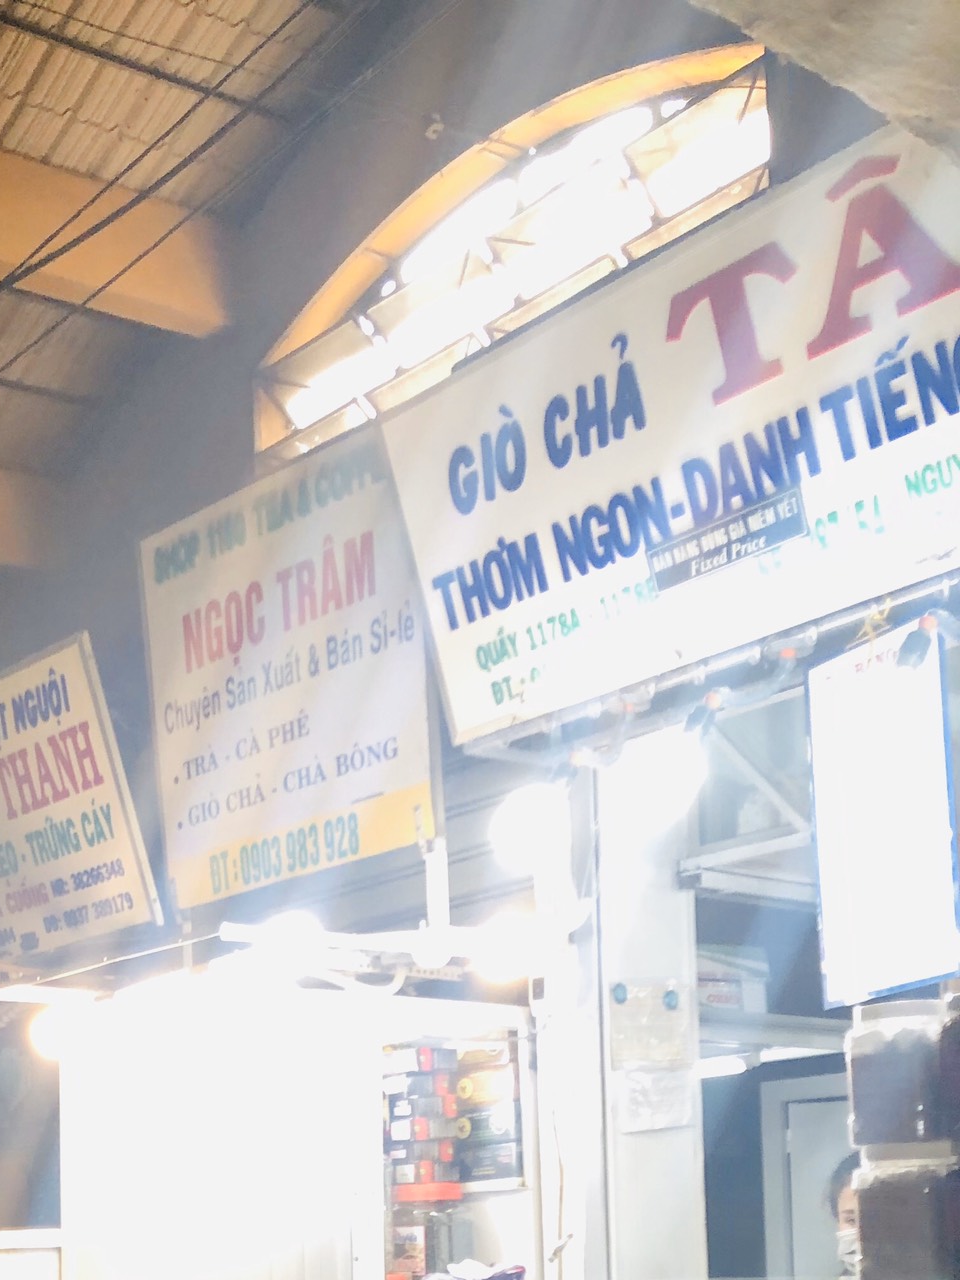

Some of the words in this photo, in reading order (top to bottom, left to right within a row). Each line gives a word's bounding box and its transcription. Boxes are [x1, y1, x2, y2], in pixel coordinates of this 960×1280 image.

[448, 403, 528, 516] GIÒ
[544, 332, 647, 470] CHẢ
[431, 530, 550, 632] THƠM
[690, 546, 728, 577] Fixed
[731, 535, 767, 561] Price
[182, 580, 266, 668] NGỌC
[275, 532, 377, 633] TRÂM
[11, 666, 71, 735] NGUỘI
[163, 687, 221, 735] Chuyên
[261, 645, 302, 697] Xuất
[325, 629, 363, 671] Bán
[335, 736, 400, 779] BÔNG
[286, 822, 320, 874] 983
[323, 812, 361, 863] 928
